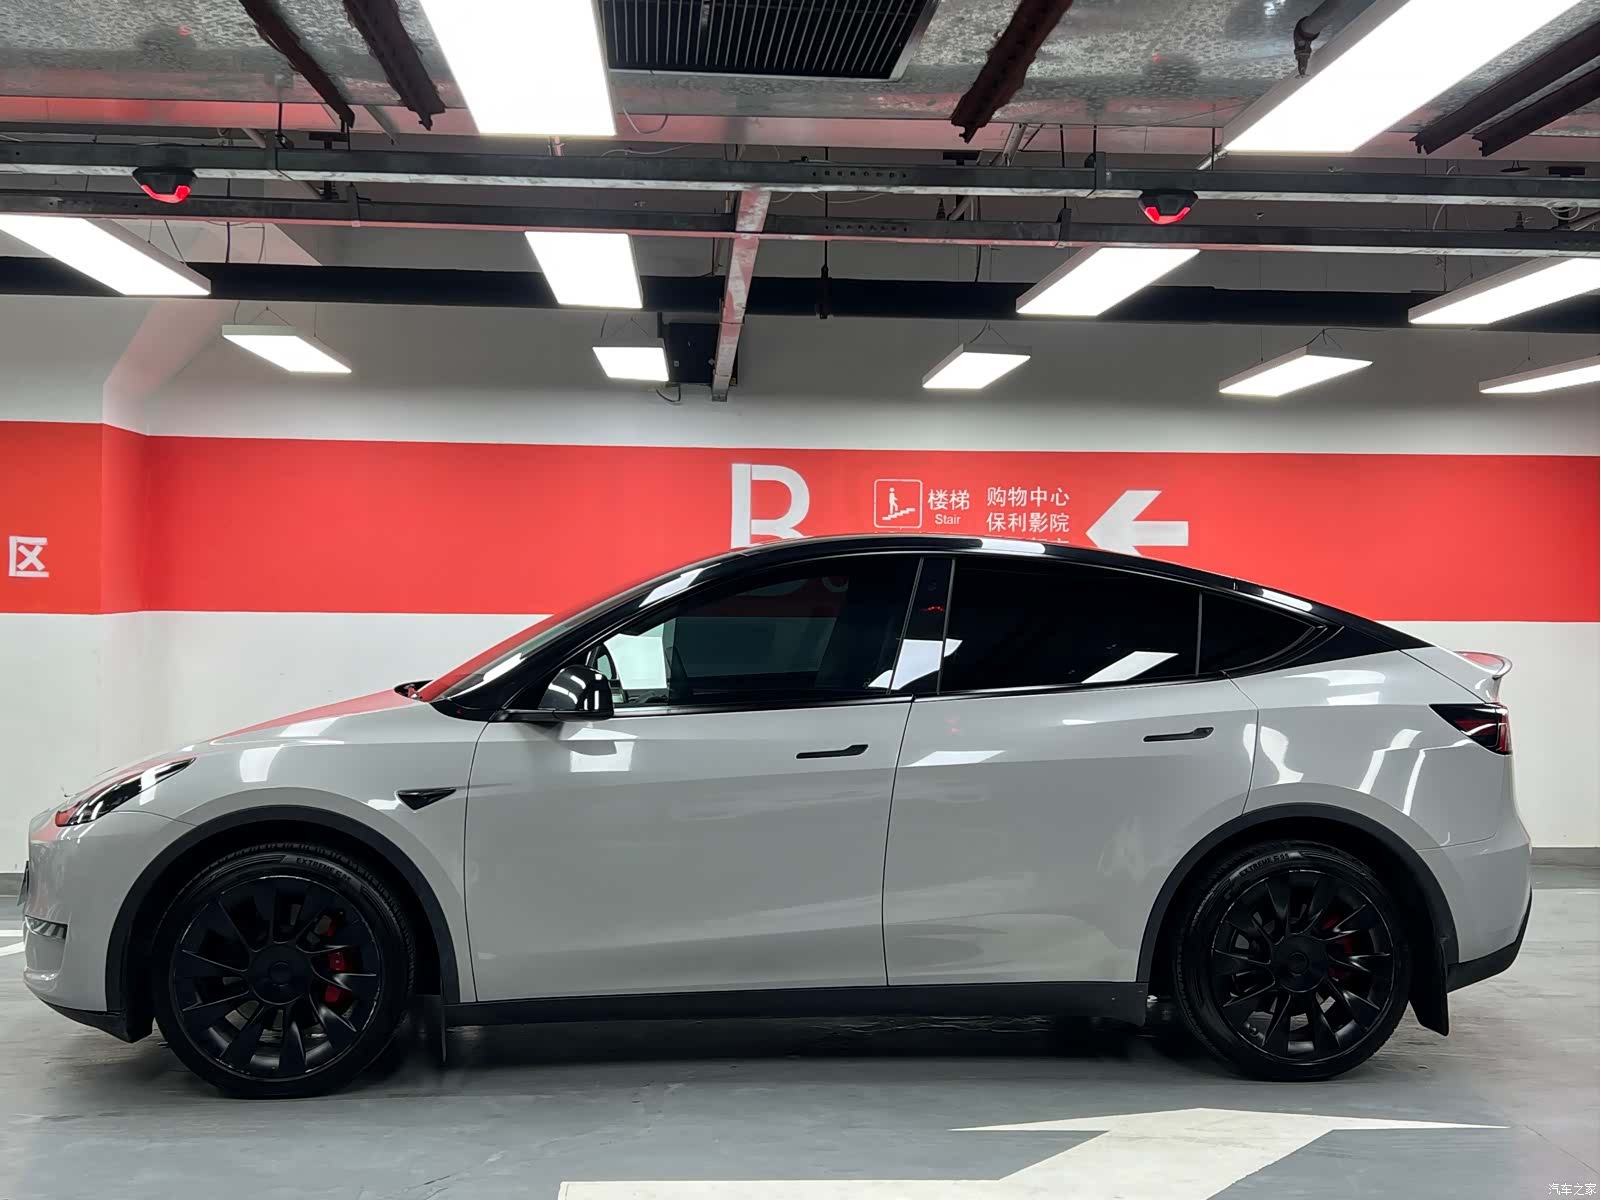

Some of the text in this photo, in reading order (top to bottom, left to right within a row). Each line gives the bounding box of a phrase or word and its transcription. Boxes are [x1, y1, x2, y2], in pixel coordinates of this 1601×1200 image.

[731, 463, 811, 549] B
[927, 488, 970, 511] 楼梯
[986, 486, 1071, 508] 购物中心
[934, 513, 961, 525] Stair
[986, 512, 1070, 533] 保利影院
[8, 535, 49, 578] 区
